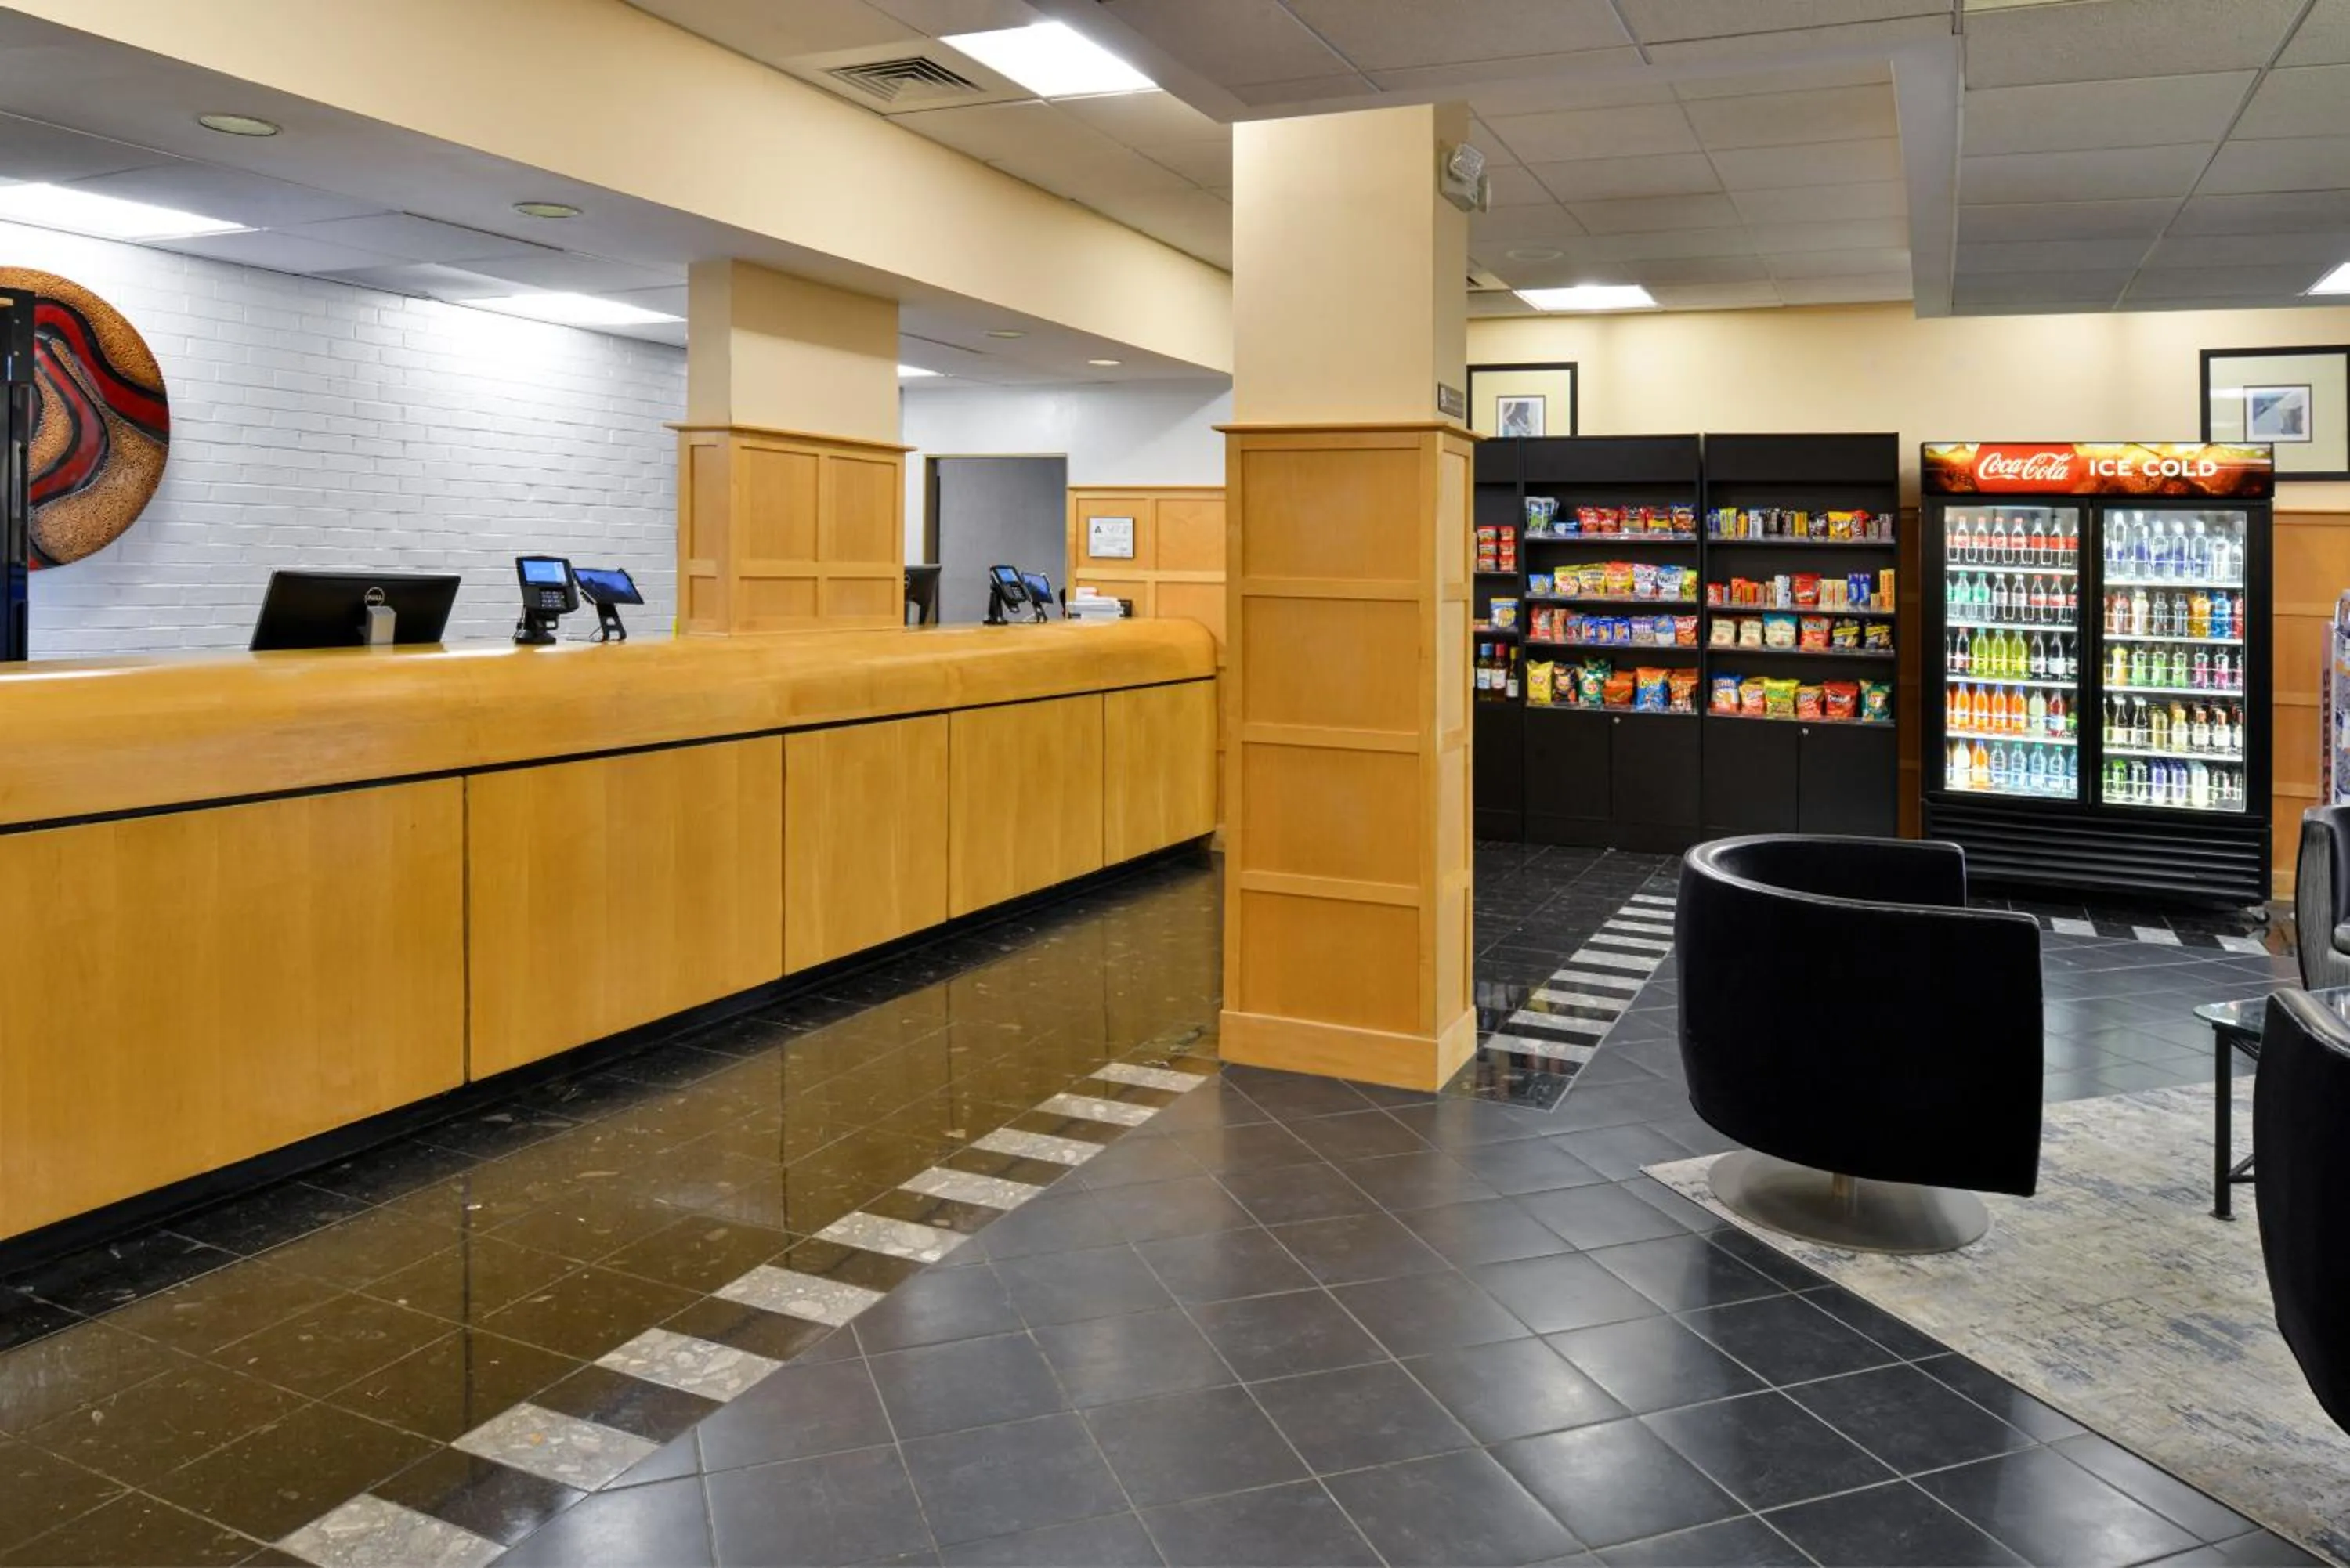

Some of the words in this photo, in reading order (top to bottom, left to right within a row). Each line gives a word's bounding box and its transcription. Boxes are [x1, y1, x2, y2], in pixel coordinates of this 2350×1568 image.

[1978, 451, 2075, 481] Coca-Cola
[2089, 459, 2133, 477] ICE
[2142, 459, 2218, 477] COLD
